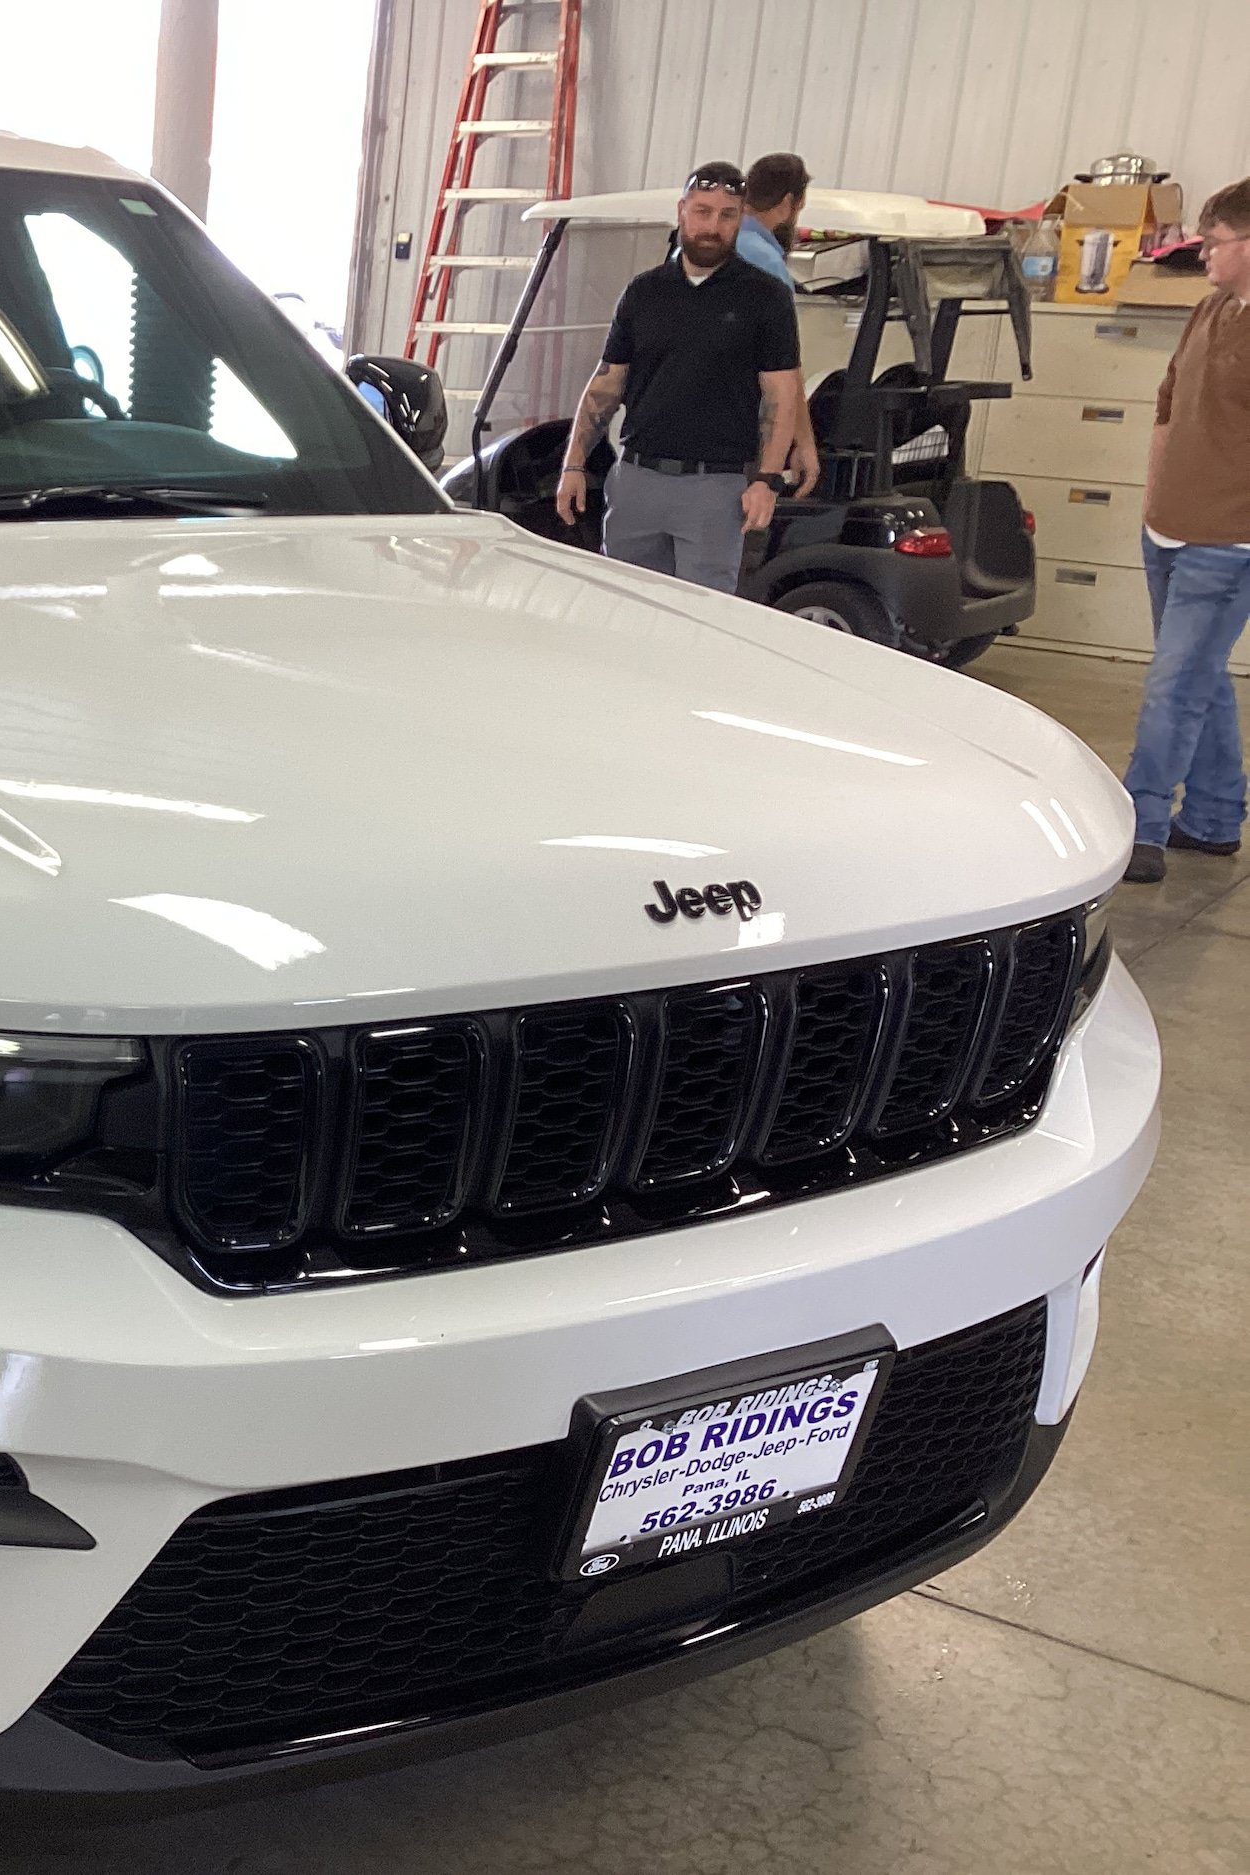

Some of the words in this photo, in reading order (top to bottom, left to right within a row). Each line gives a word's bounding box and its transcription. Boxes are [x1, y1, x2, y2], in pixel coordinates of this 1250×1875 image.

[644, 880, 762, 923] Jeep
[676, 1401, 732, 1427] BOB
[730, 1374, 834, 1416] RIDINGS
[608, 1432, 688, 1479] BOB
[700, 1390, 859, 1452] RIDINGS
[599, 1422, 851, 1503] Chrysler-Dodge-Jeep-Ford
[682, 1476, 729, 1497] Pana,
[735, 1469, 751, 1483] IL
[639, 1478, 777, 1534] 562-3986
[706, 1508, 769, 1544] ILLINOIS
